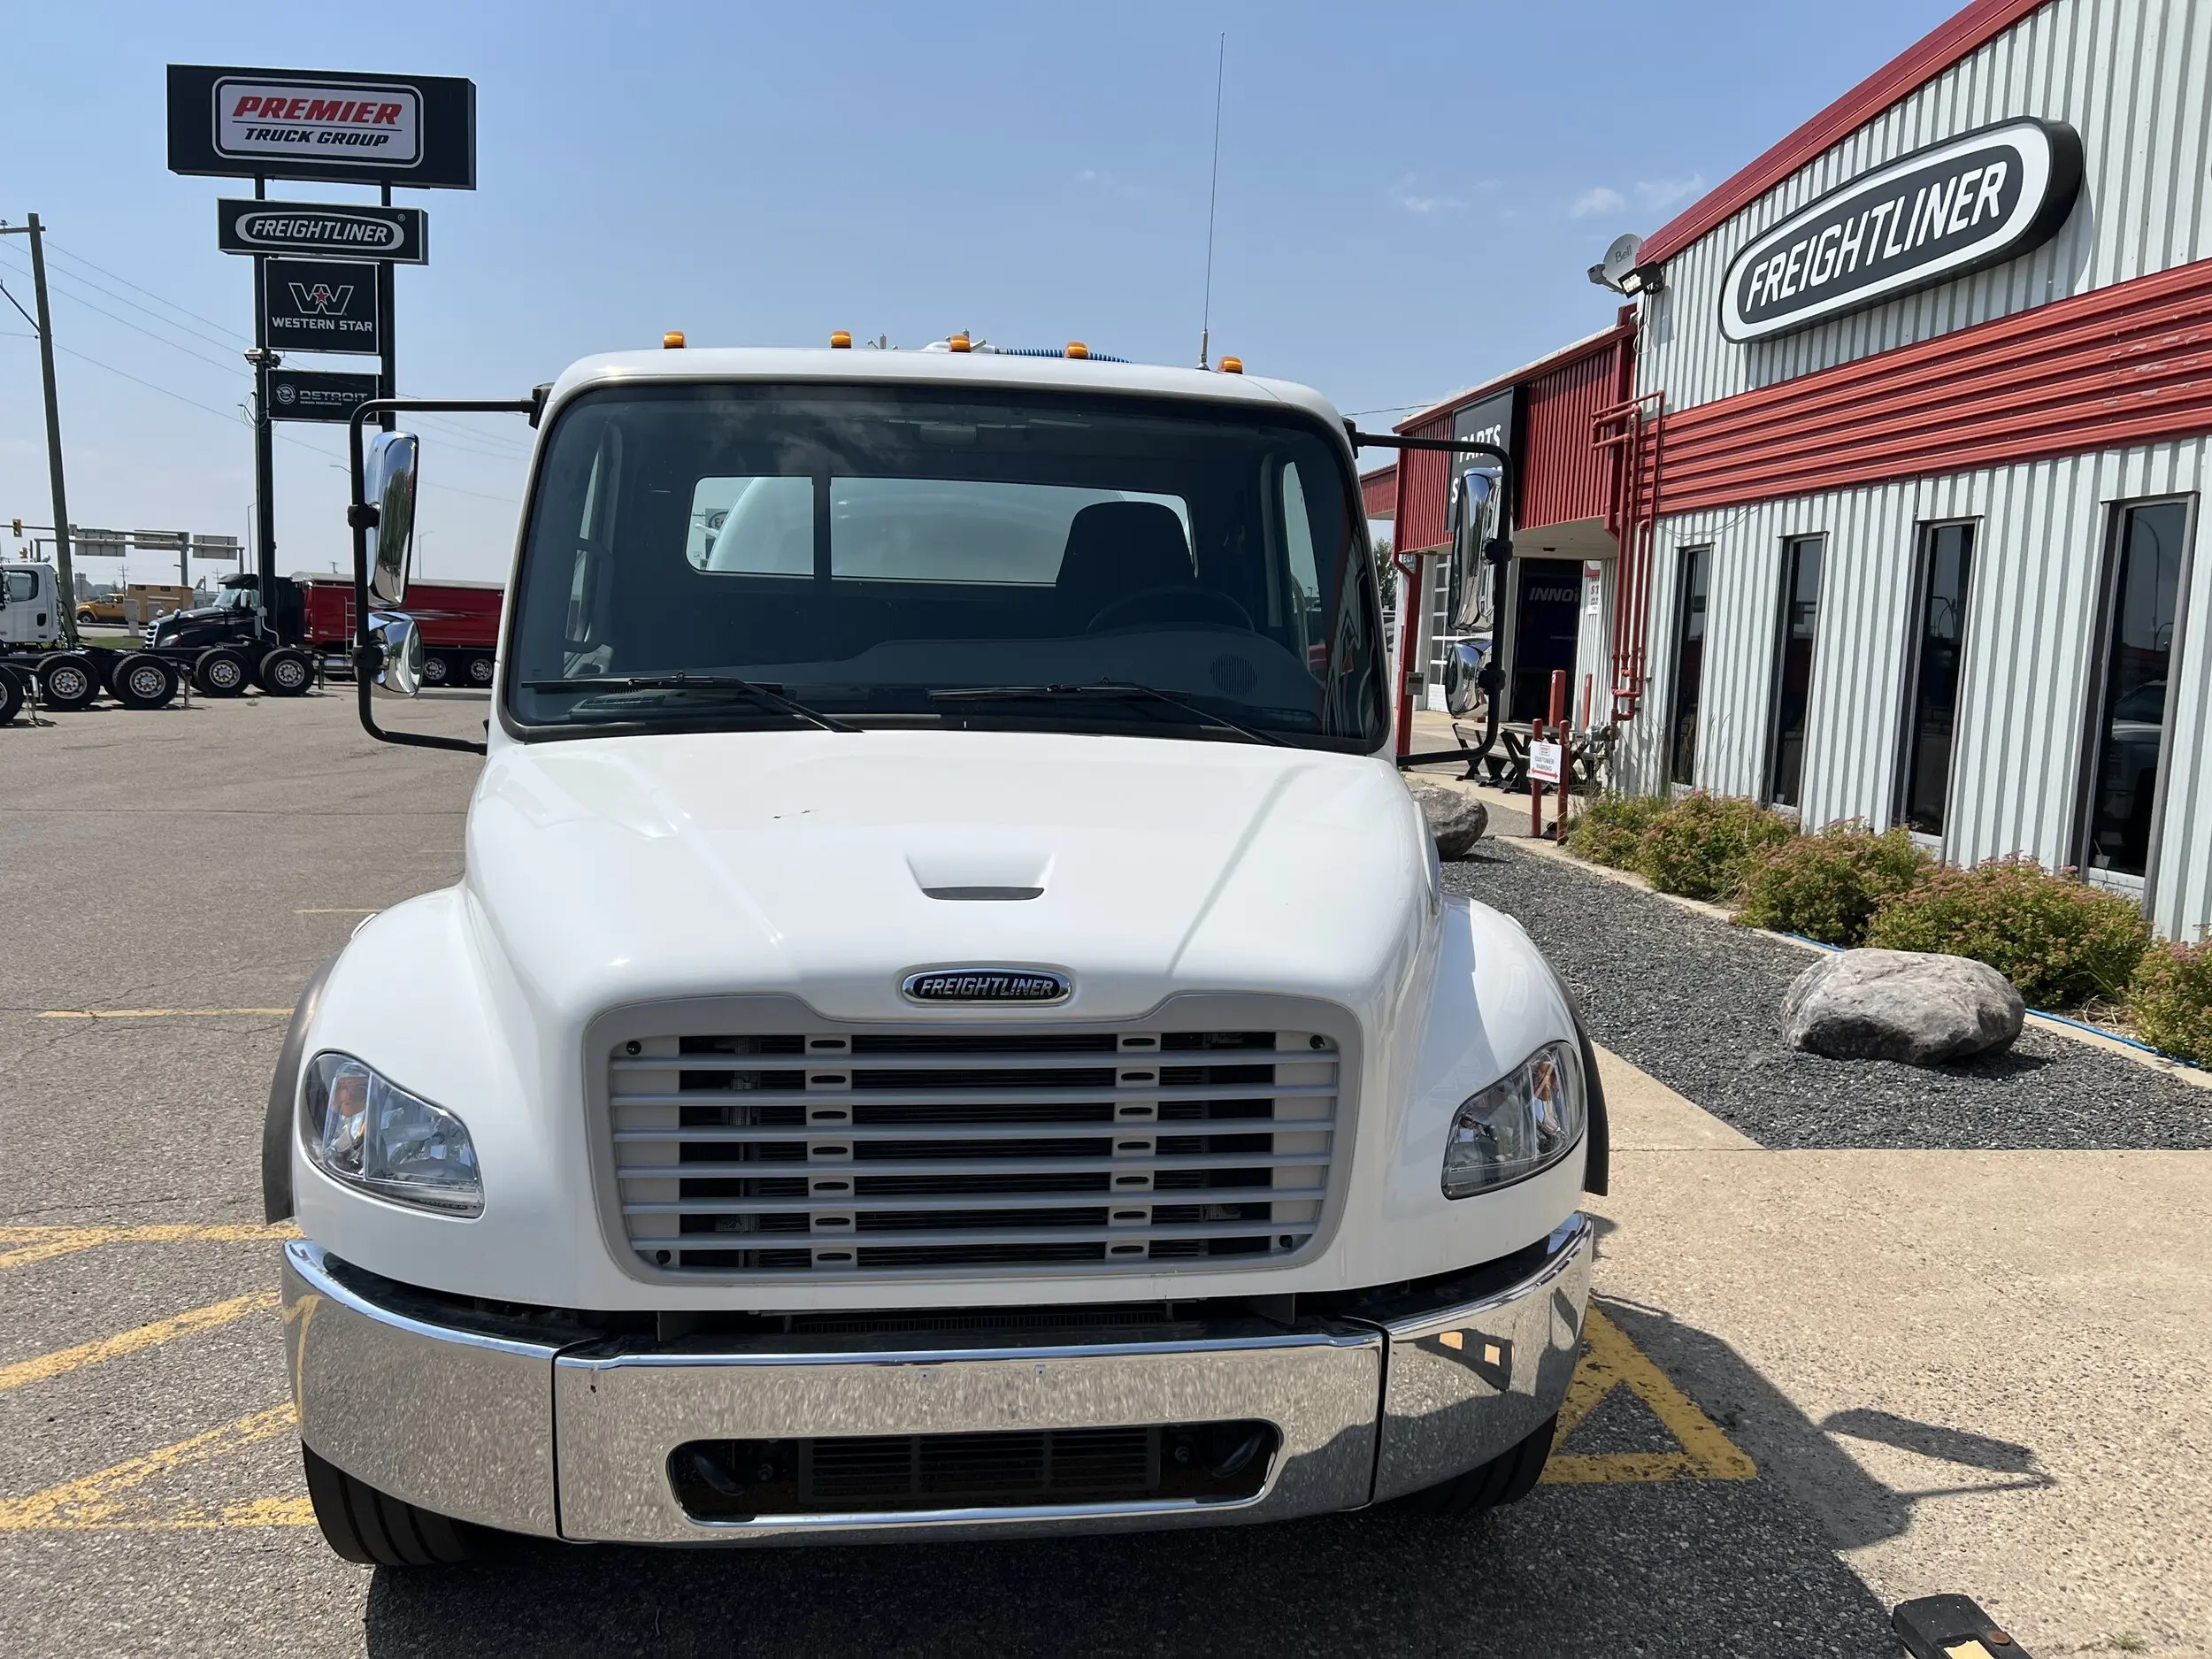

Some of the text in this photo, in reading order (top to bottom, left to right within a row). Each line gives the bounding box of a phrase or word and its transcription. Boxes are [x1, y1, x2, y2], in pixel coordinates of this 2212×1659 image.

[232, 96, 403, 125] PREMIER
[244, 127, 389, 148] TRUCK GROUP
[251, 219, 388, 242] FREIGHTLINER
[1745, 160, 2008, 313] FREIGHTLINER
[1615, 244, 1632, 264] Bell
[272, 317, 373, 332] WESTERN STAR
[299, 390, 368, 402] DETROIT
[1534, 756, 1555, 765] CUSTOMER
[919, 977, 1054, 995] FREIGHTLINER
